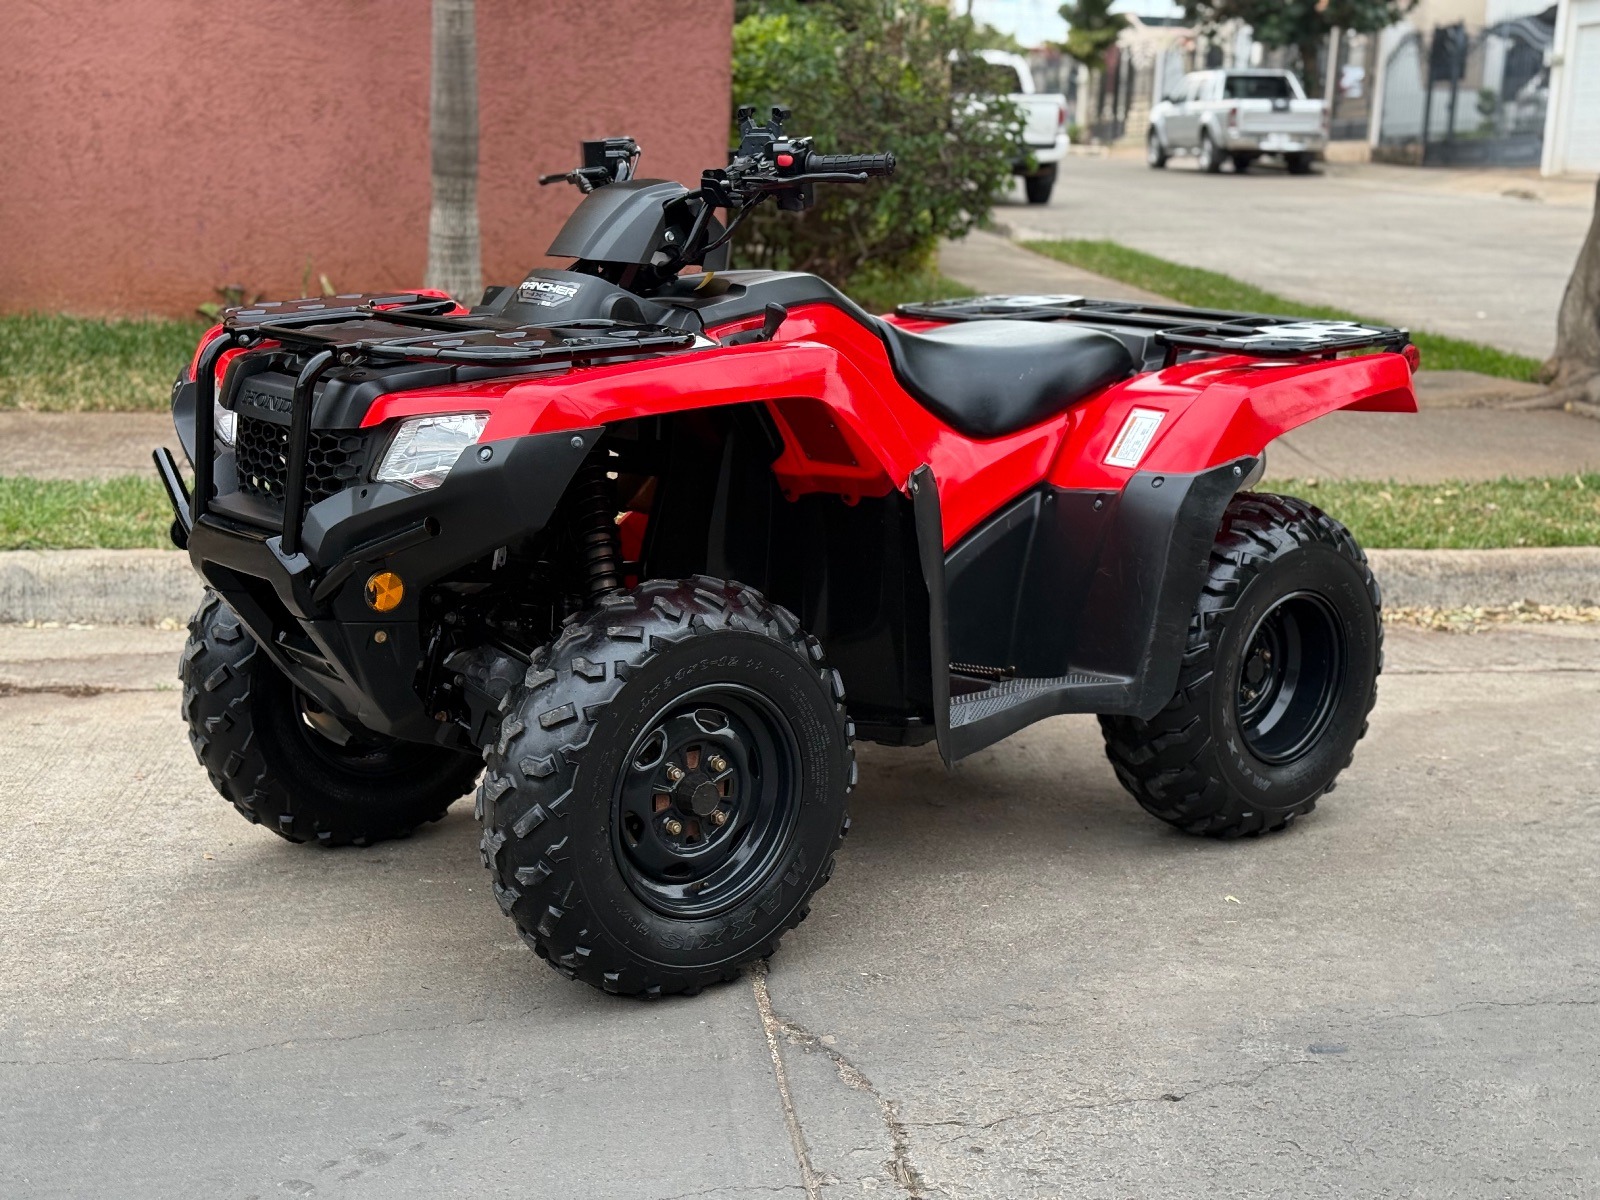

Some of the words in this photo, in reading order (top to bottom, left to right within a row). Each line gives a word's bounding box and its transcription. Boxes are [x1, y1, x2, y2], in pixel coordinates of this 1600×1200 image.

[519, 281, 578, 298] RANCHER
[242, 389, 293, 414] HOND
[658, 847, 807, 951] MAXXIS
